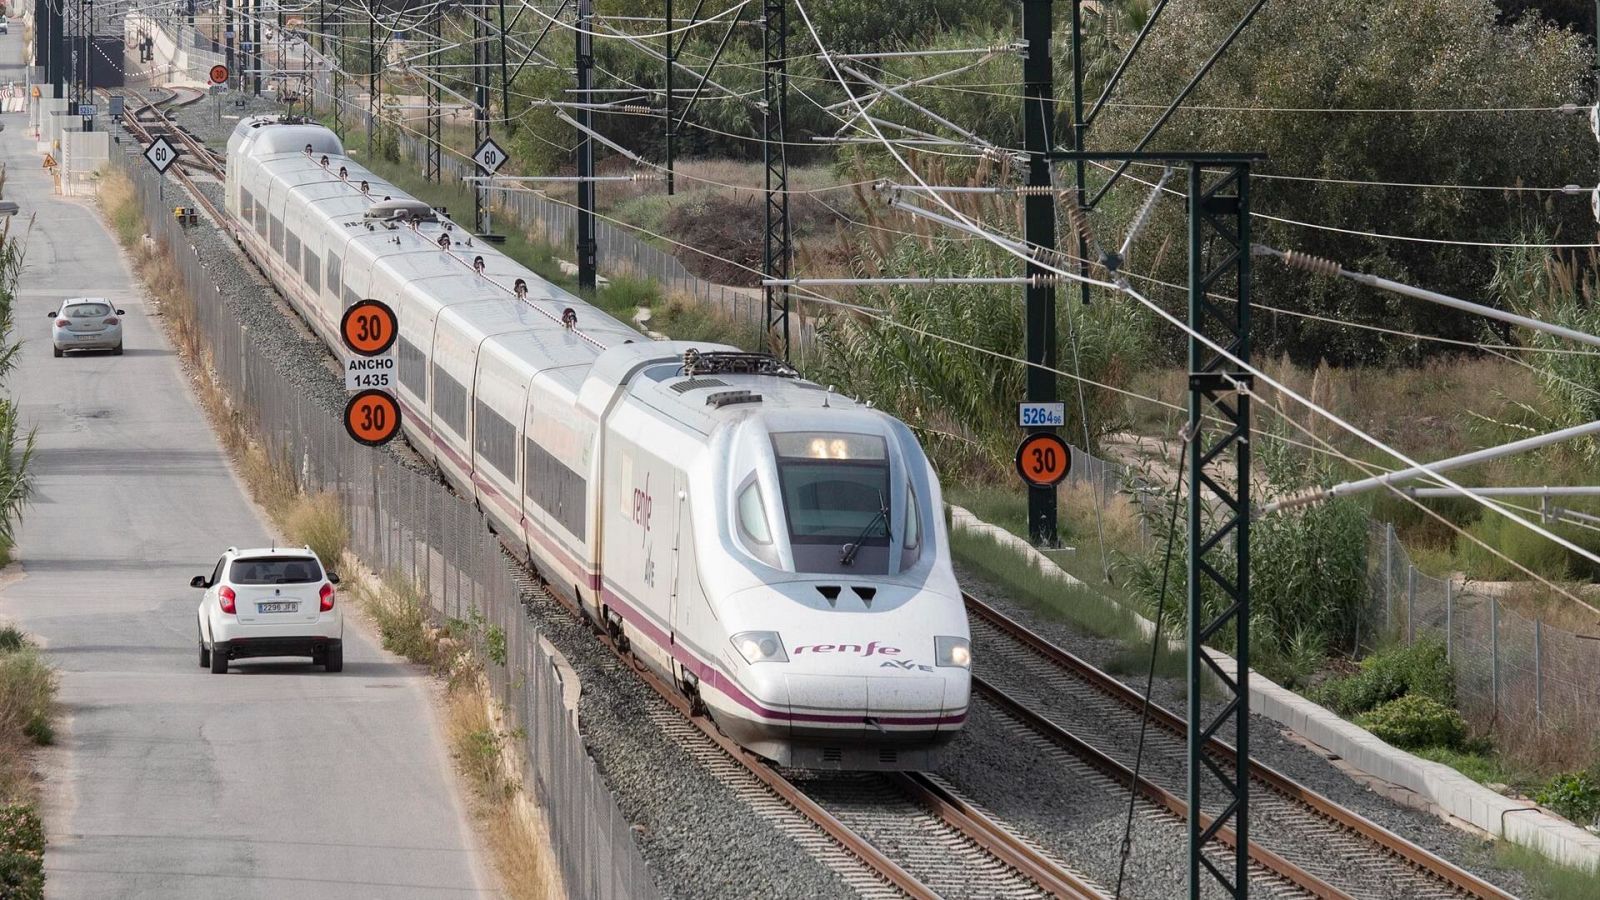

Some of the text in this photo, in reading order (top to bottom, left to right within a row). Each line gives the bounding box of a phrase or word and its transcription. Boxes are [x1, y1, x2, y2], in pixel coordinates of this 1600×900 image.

[155, 147, 167, 162] 60
[484, 150, 496, 165] 60
[356, 314, 382, 342] 30
[349, 358, 394, 371] ANCHO
[354, 373, 389, 387] 1435
[360, 404, 386, 431] 30
[1031, 447, 1056, 474] 30
[632, 471, 652, 549] renfe
[793, 641, 902, 658] renfe
[879, 658, 934, 673] AVE
